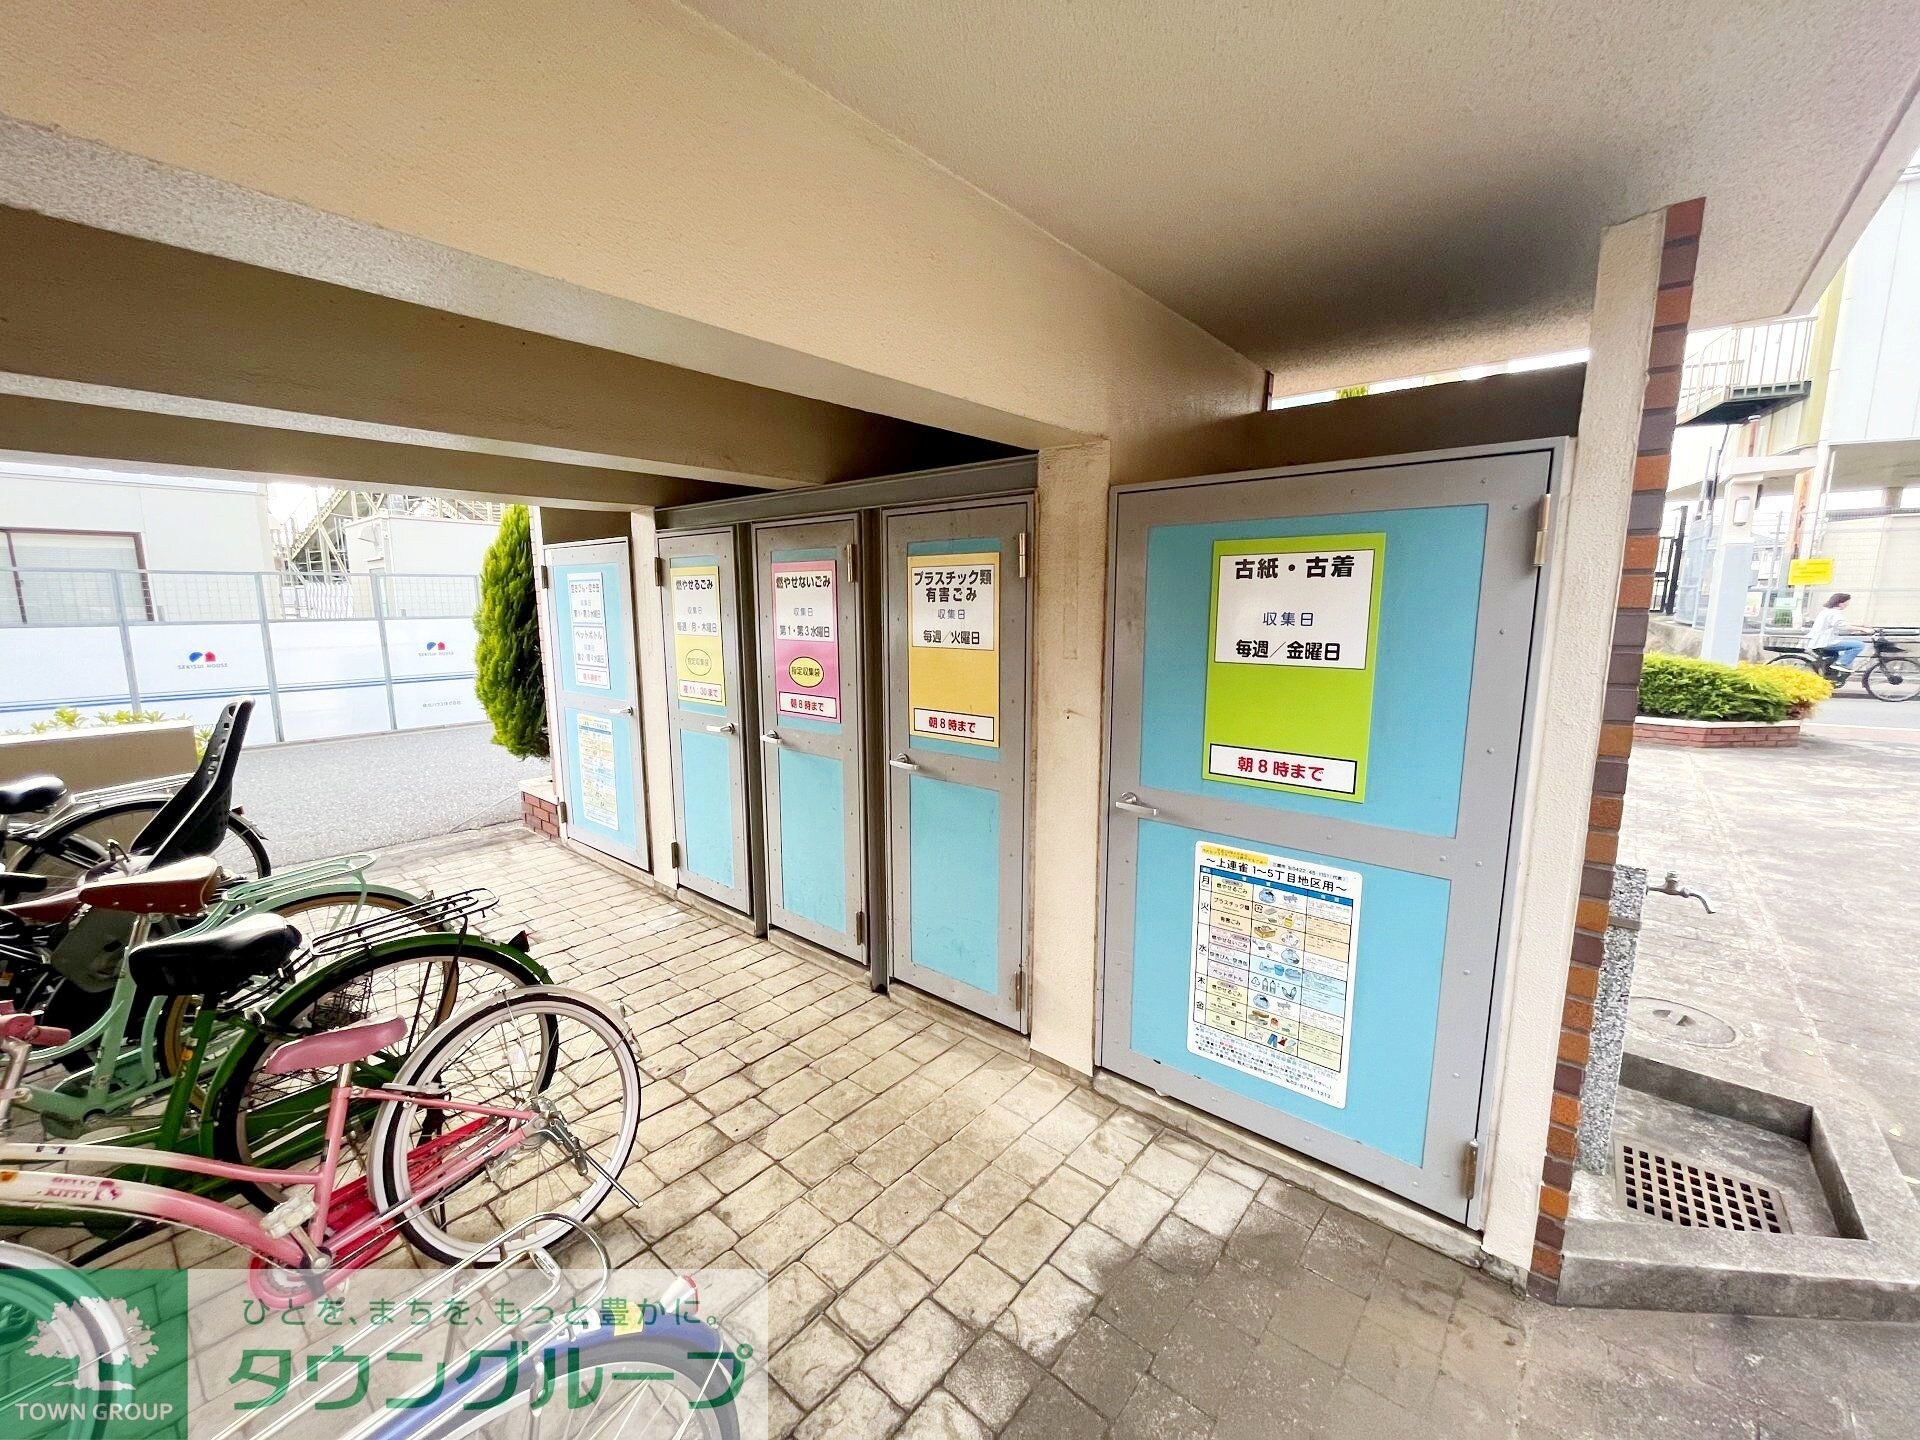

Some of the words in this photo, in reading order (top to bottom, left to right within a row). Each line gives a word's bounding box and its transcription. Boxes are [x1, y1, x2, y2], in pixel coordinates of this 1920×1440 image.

[1235, 555, 1354, 580] 古紙・古着
[676, 579, 713, 590] 燃やせるごみ
[776, 575, 831, 589] 燃やせないごみ
[914, 569, 992, 587] プラスチック類
[926, 587, 978, 603] 有害ごみ
[793, 607, 814, 617] 収集日
[937, 608, 966, 620] 収集日
[1262, 611, 1314, 627] 収集日
[923, 629, 980, 646] 毎週／火曜日
[1236, 639, 1341, 661] 毎週／金曜日
[790, 698, 824, 713] 朝8時まで
[928, 716, 976, 734] 朝8時まで
[1238, 756, 1325, 782] 朝8時まで
[1202, 876, 1210, 885] 月
[1200, 902, 1209, 911] 火
[1198, 944, 1207, 952] 水
[45, 1189, 92, 1199] KITTY
